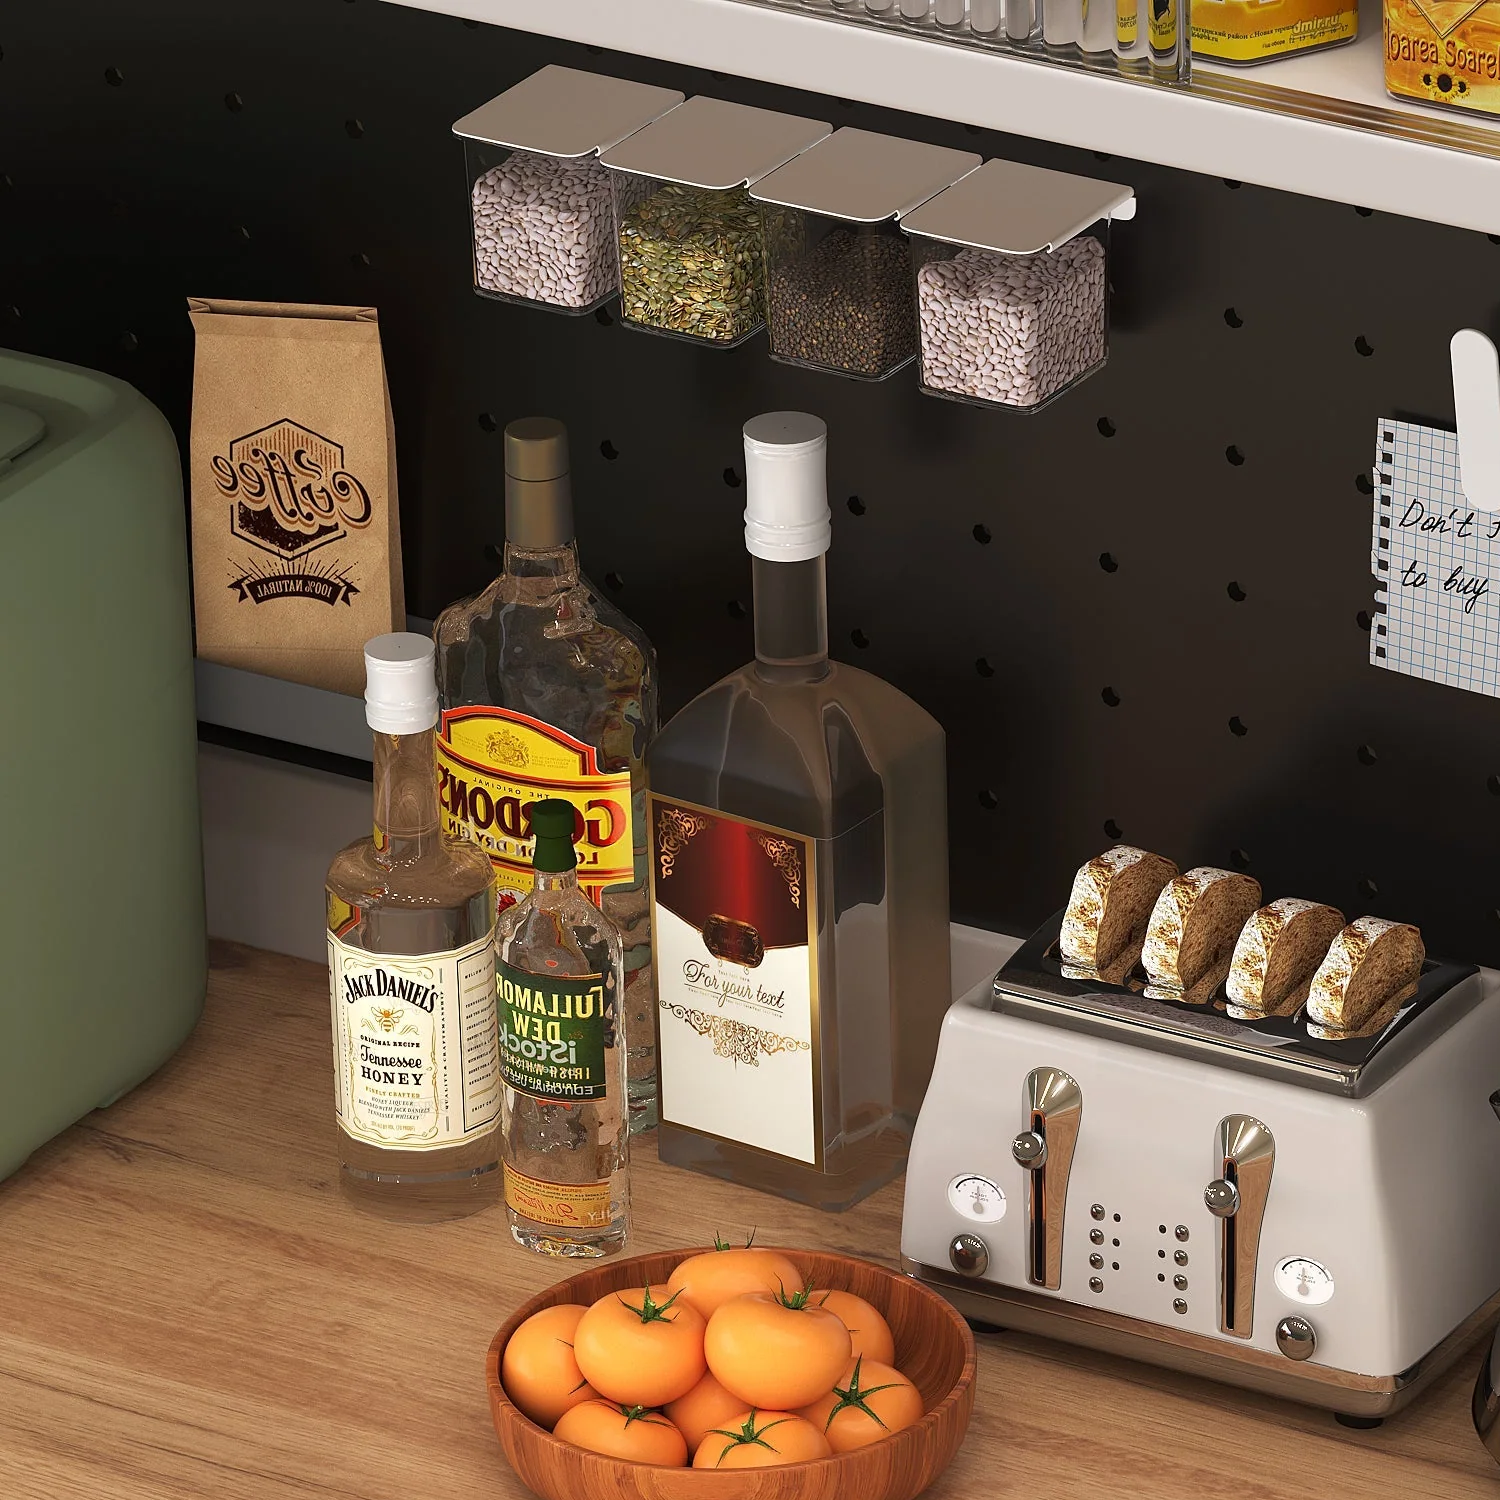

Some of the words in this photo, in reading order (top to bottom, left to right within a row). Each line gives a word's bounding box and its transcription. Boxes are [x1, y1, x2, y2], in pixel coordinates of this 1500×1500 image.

[1293, 15, 1339, 34] dmir.ru
[1385, 18, 1438, 64] loarea
[1399, 498, 1475, 538] Don't
[1400, 560, 1428, 588] to
[1443, 566, 1489, 614] buy
[344, 973, 376, 1004] JACK
[376, 968, 440, 1014] DANIEL'S
[682, 959, 719, 990] For
[718, 980, 754, 1008] your
[756, 984, 785, 1009] text
[360, 1034, 390, 1047] ORIGINAL
[360, 1044, 422, 1069] Tennessee
[361, 1065, 424, 1086] HONEY
